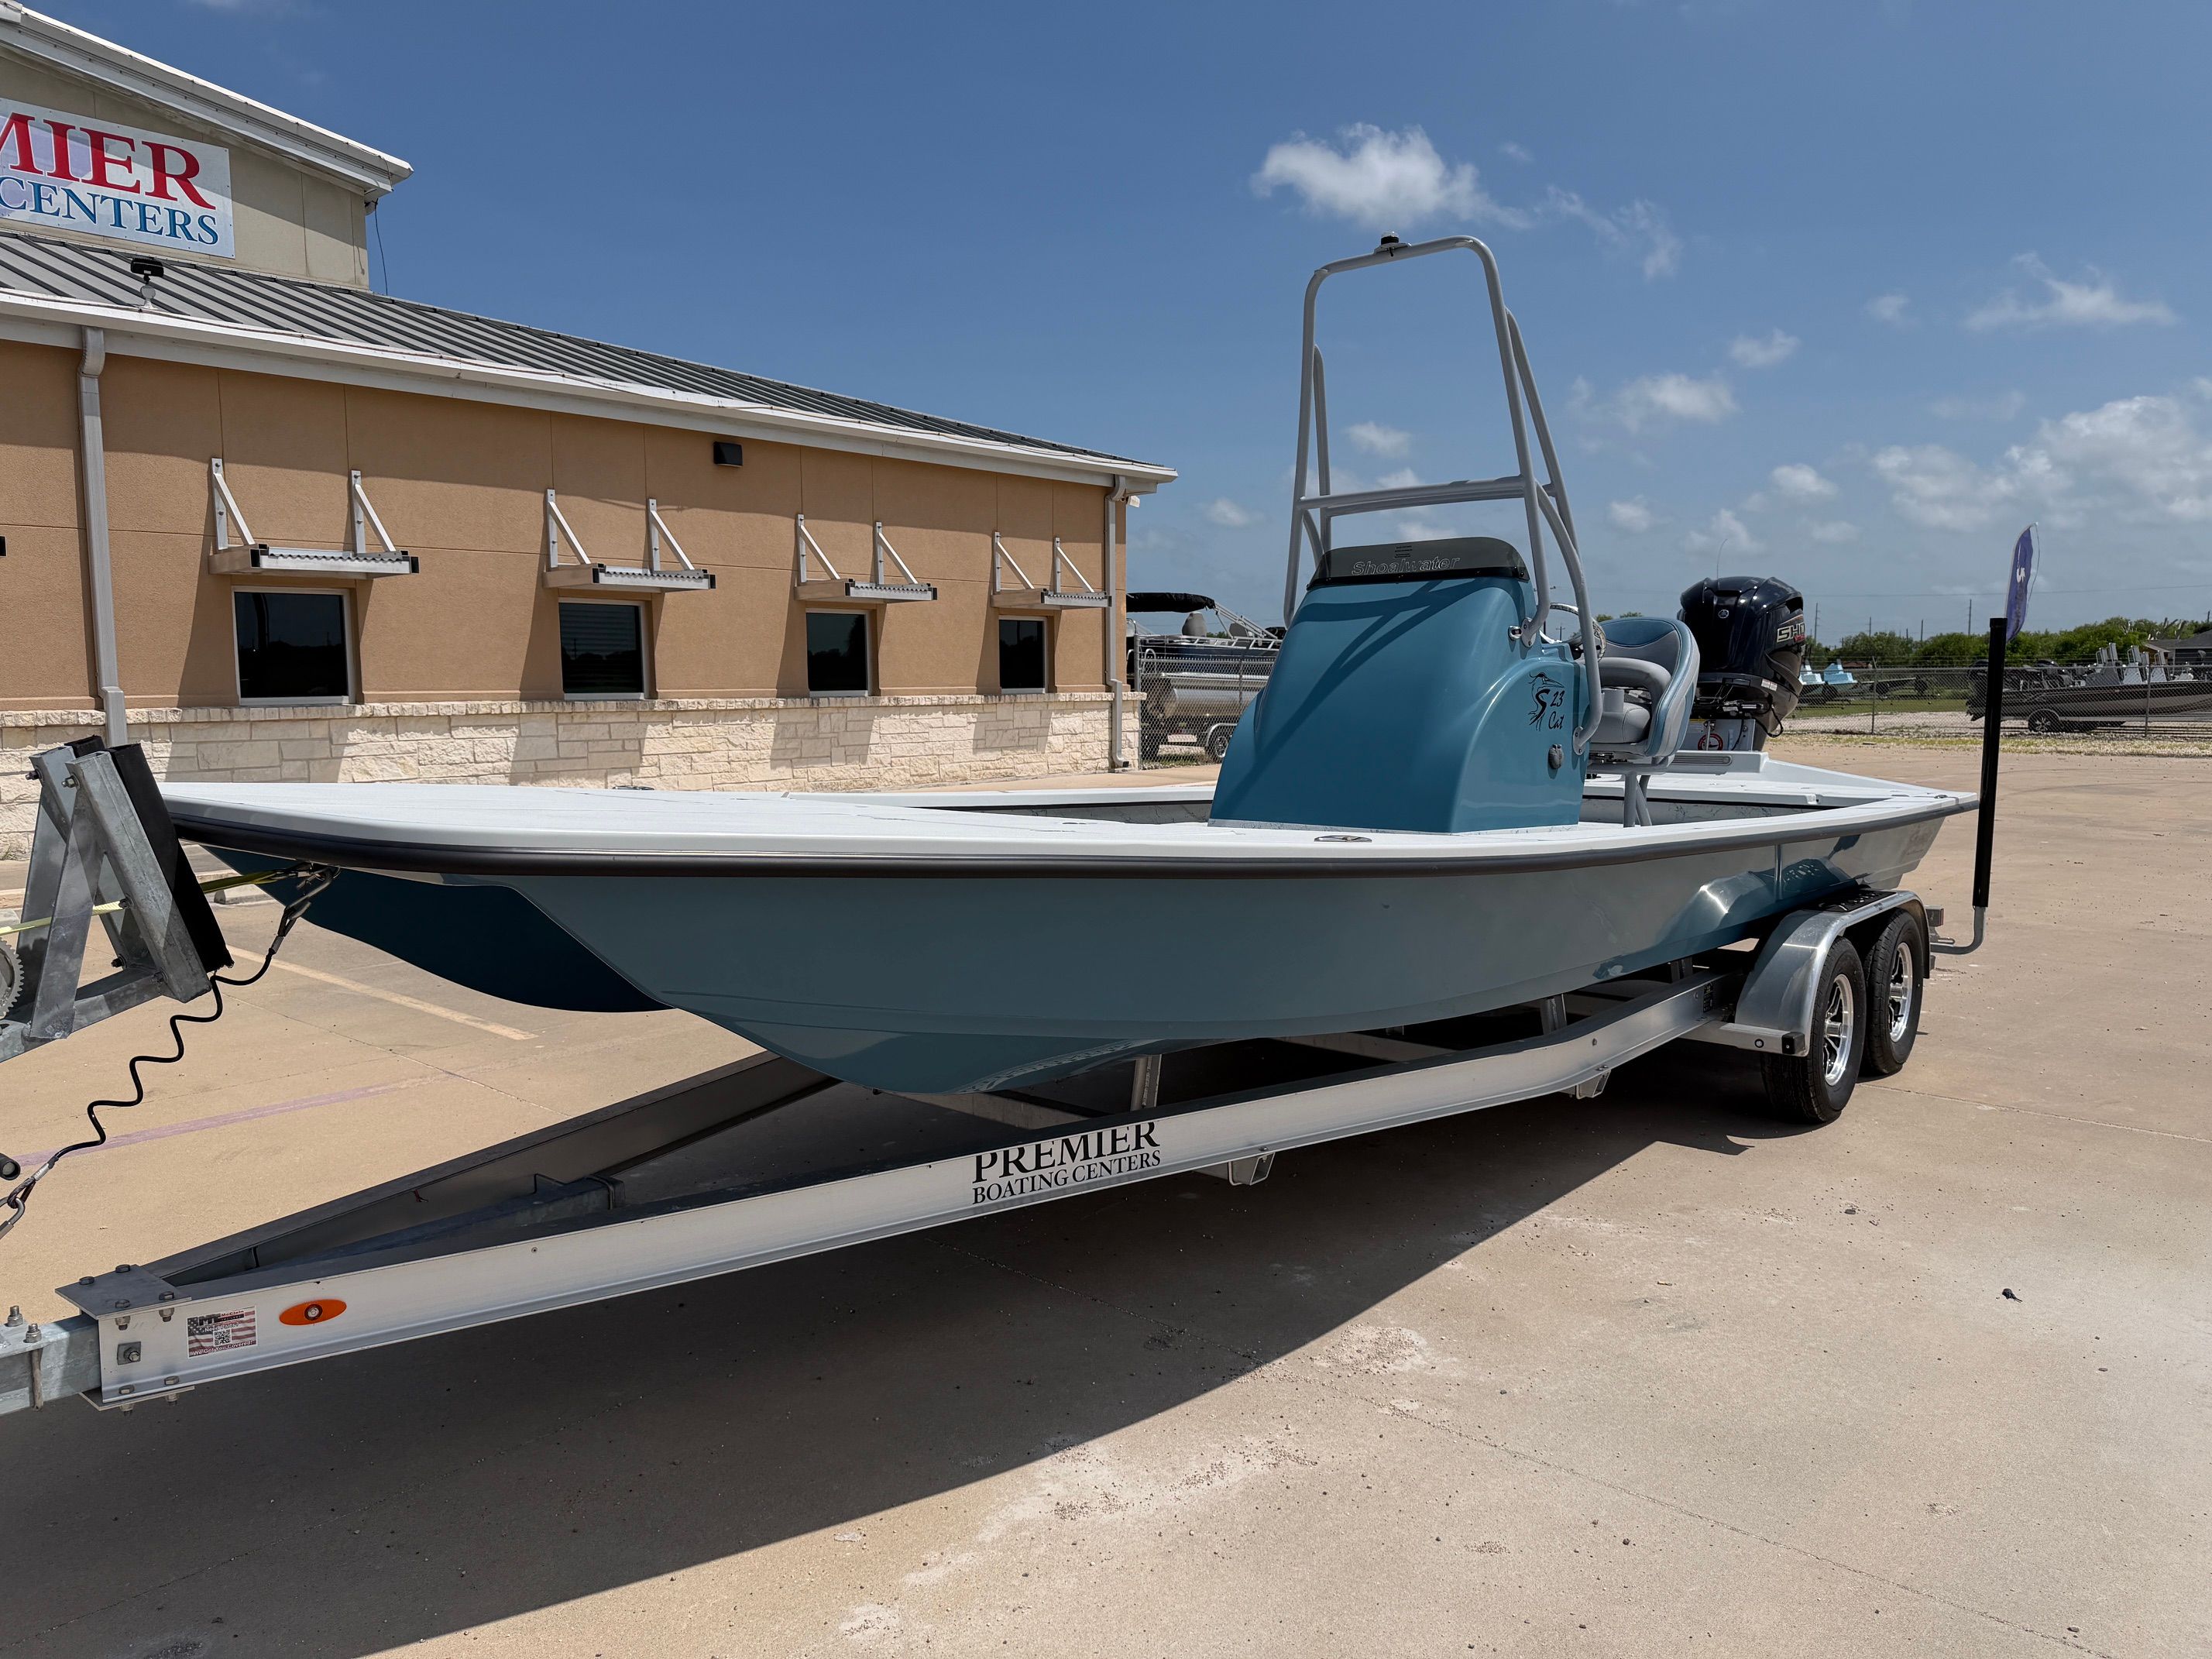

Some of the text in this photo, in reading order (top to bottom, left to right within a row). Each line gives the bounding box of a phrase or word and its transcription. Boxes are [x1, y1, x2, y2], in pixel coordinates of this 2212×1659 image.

[0, 177, 218, 245] CENTERS
[1351, 556, 1461, 576] Shoalwater
[1550, 690, 1565, 707] 23
[1548, 710, 1565, 730] Cat
[972, 1121, 1160, 1183] PREMIER
[972, 1150, 1161, 1204] BOATING CENTERS
